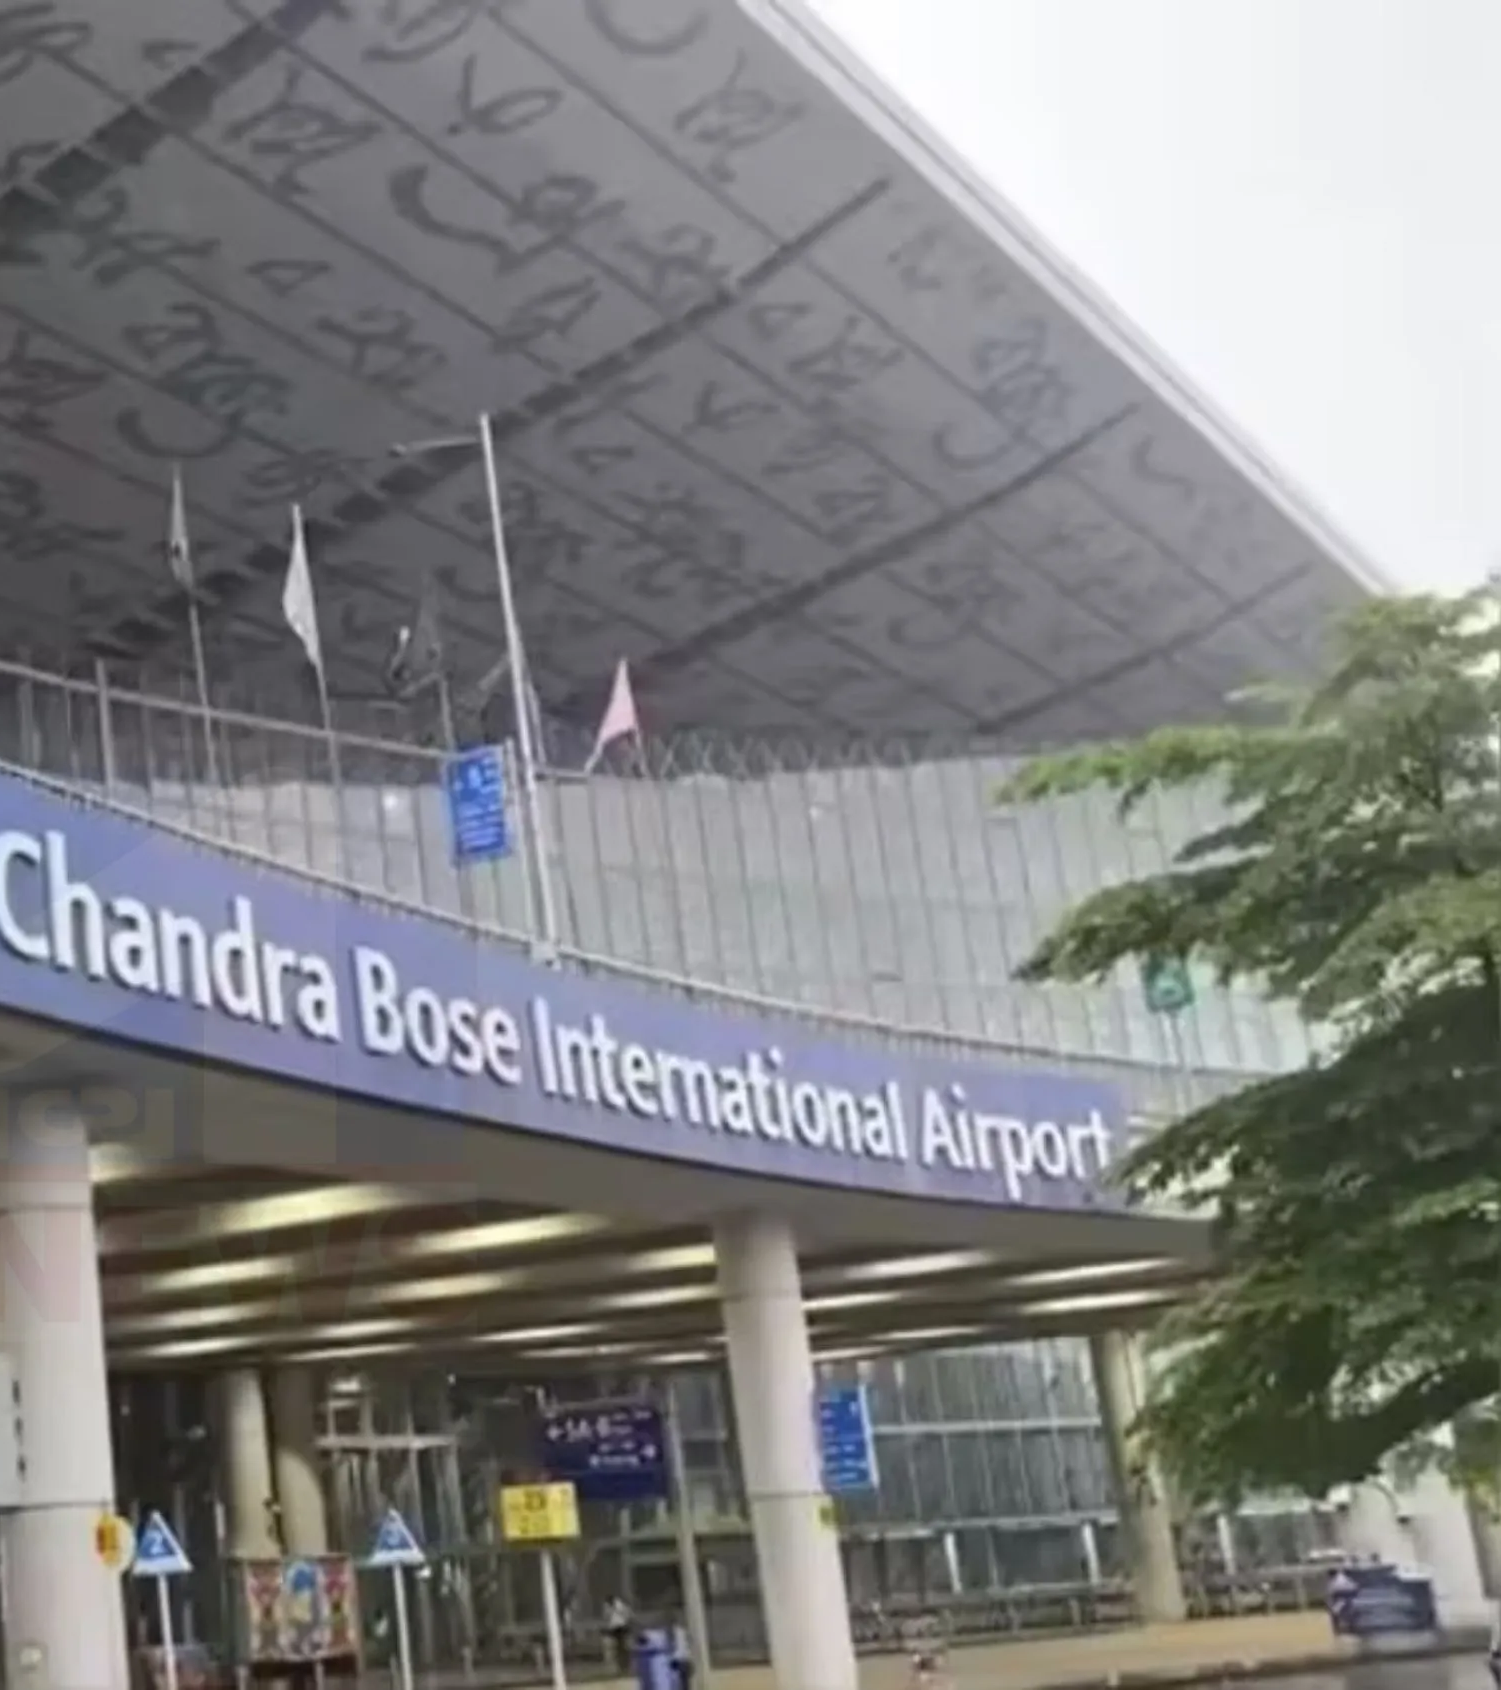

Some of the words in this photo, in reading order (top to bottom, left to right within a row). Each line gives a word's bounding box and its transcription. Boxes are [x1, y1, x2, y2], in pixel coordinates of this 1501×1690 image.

[354, 946, 522, 1085] Bose
[531, 998, 907, 1160] International
[922, 1084, 1112, 1199] Airport
